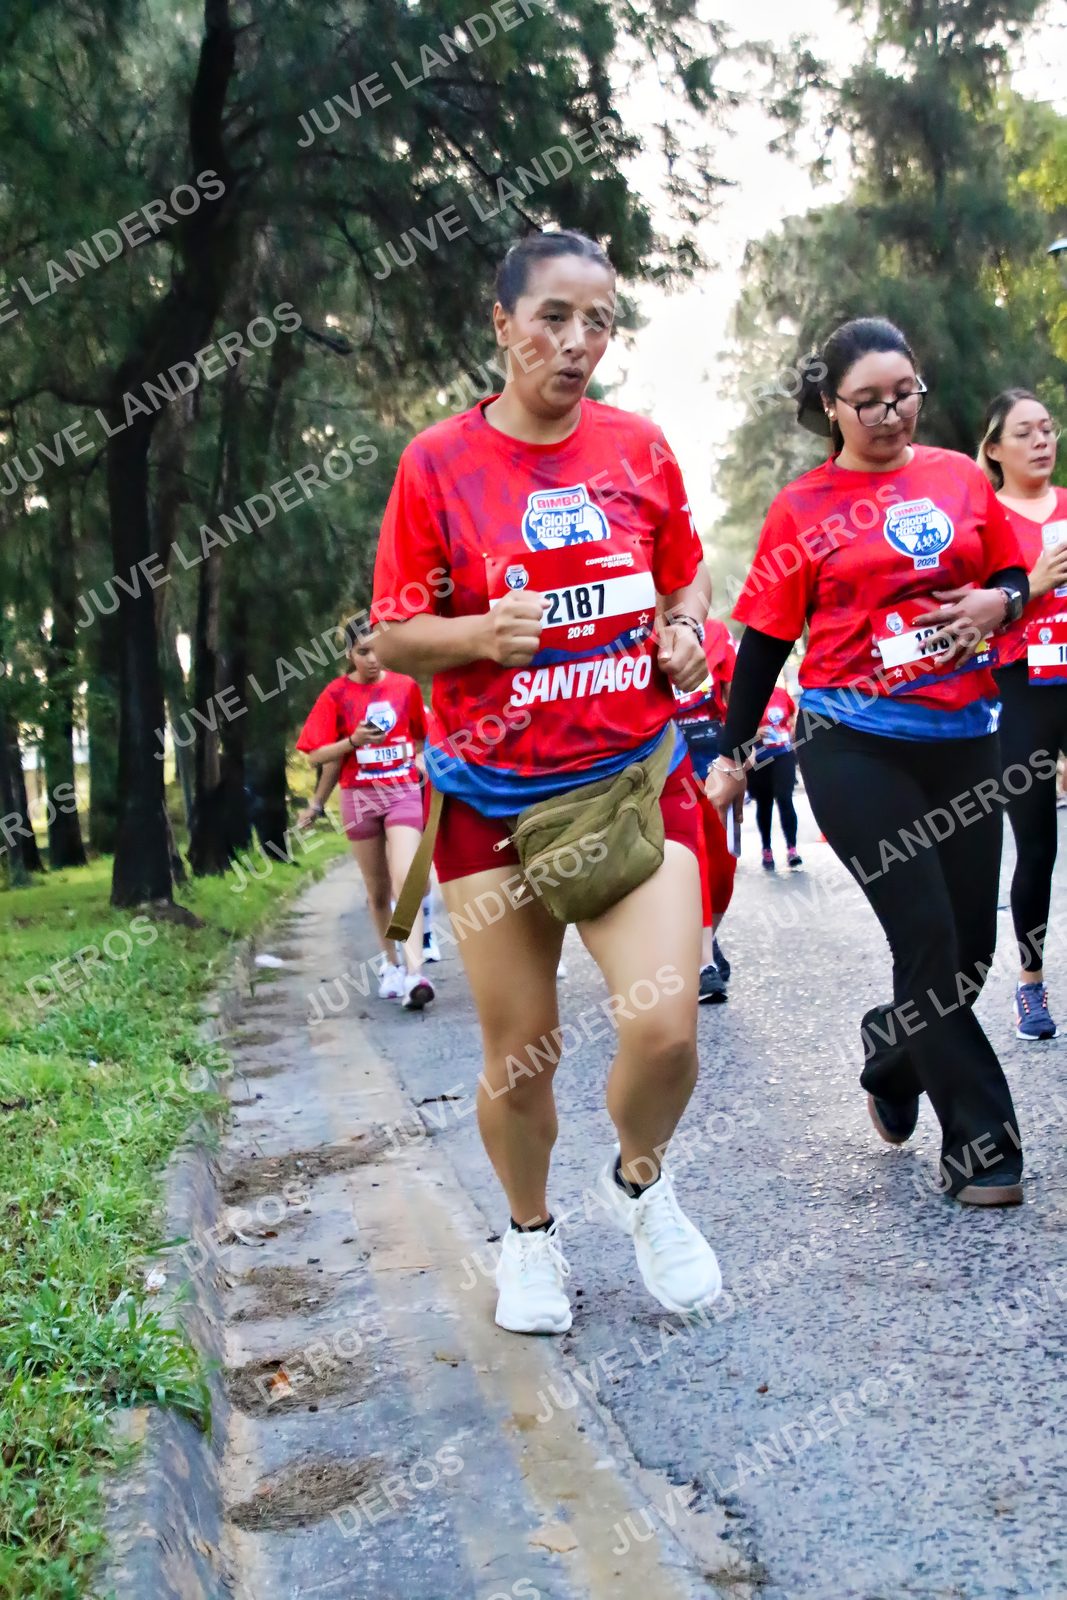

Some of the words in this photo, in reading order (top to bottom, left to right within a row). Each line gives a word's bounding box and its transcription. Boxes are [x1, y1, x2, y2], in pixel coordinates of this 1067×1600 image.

[537, 494, 581, 509] BIMBO
[541, 508, 583, 528] Global
[899, 513, 933, 528] Global
[537, 525, 571, 538] Race
[895, 523, 923, 538] Race
[916, 557, 937, 568] 2026
[544, 583, 605, 624] 2187
[510, 655, 652, 707] SANTIAGO
[374, 747, 398, 761] 2195
